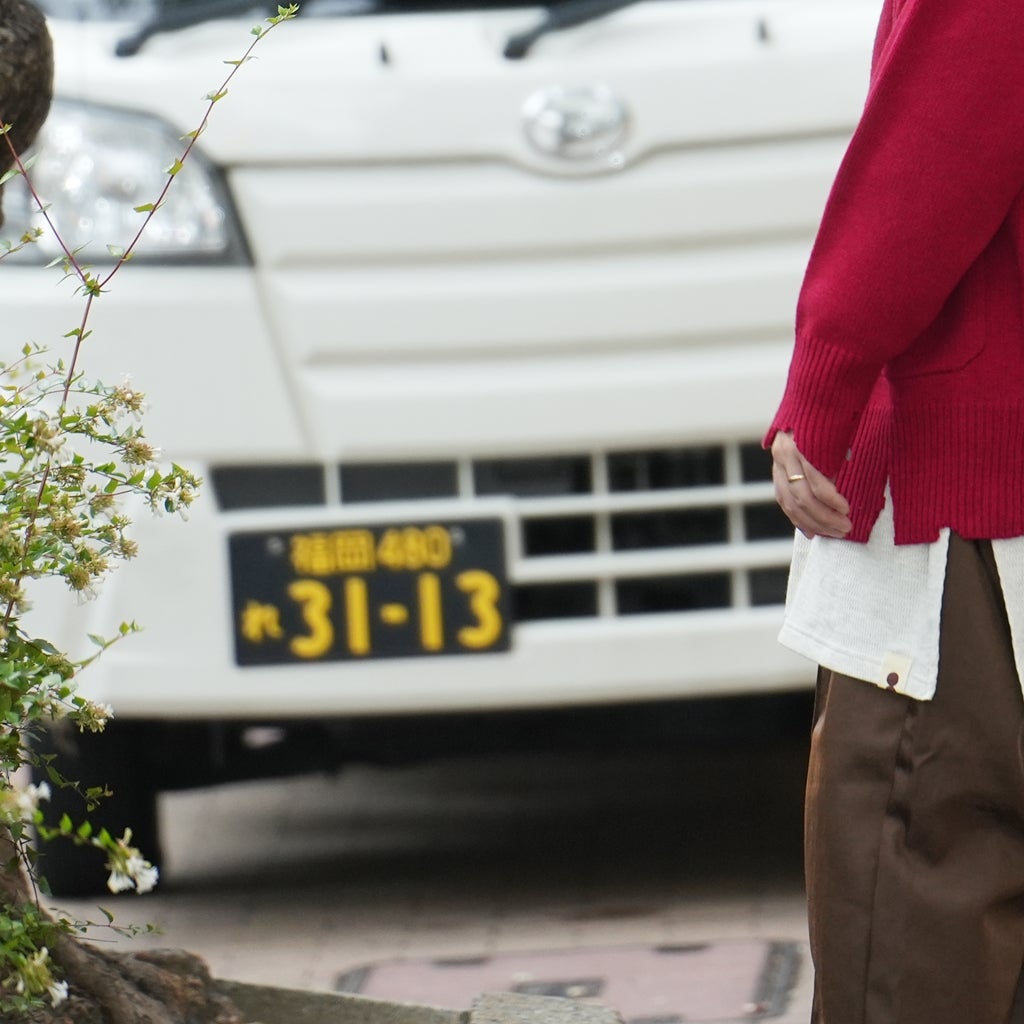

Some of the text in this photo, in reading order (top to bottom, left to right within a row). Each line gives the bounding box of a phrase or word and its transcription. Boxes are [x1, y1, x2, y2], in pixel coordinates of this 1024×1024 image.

[290, 525, 453, 575] 福岡 480
[287, 569, 502, 659] 31-13
